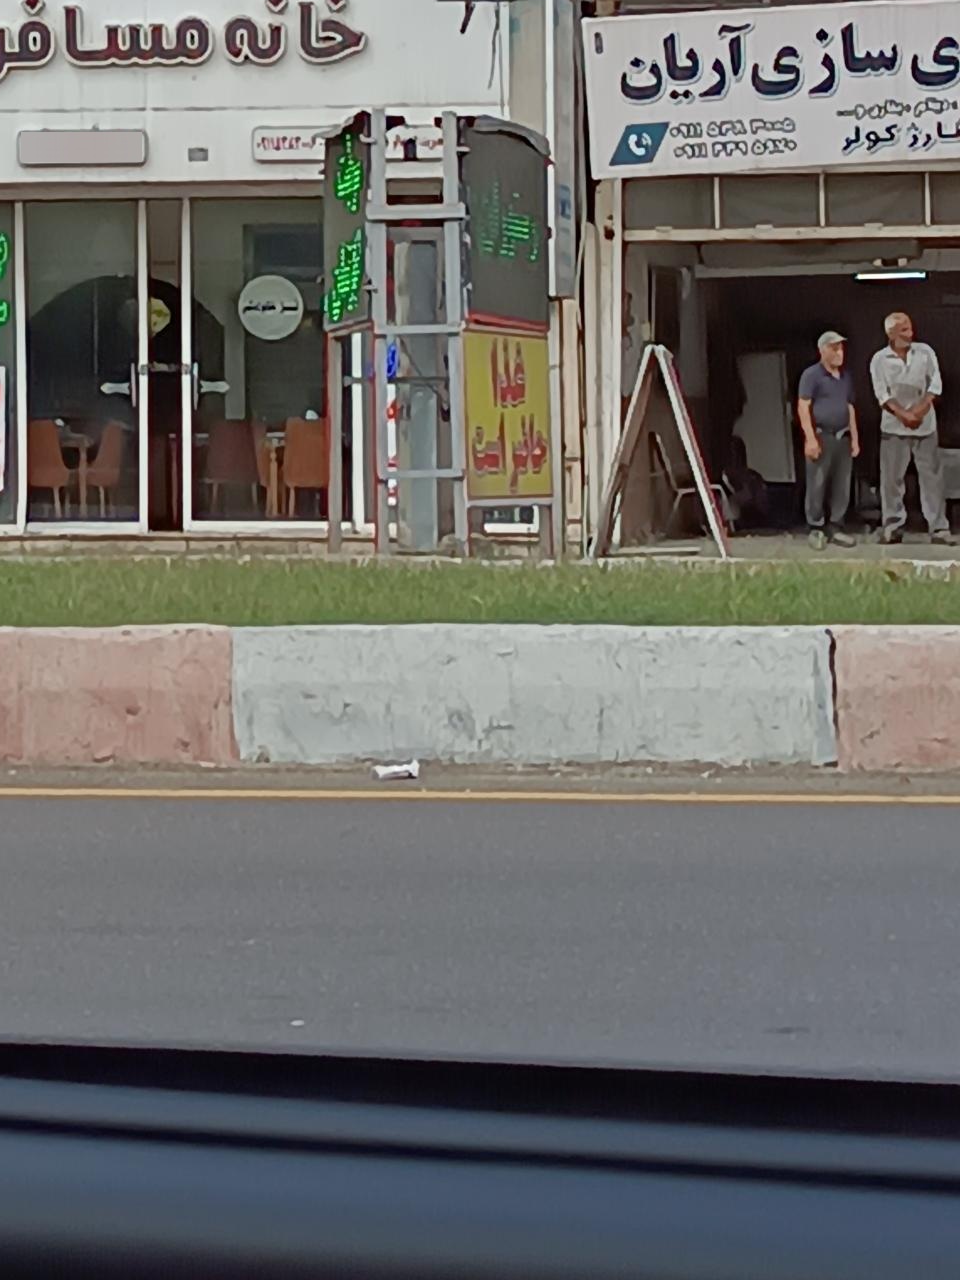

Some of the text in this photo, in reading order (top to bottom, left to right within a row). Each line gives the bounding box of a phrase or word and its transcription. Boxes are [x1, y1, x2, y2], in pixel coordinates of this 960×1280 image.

[620, 22, 754, 104] آریان
[751, 21, 902, 99] سازی
[841, 120, 960, 154] ارژ کولر
